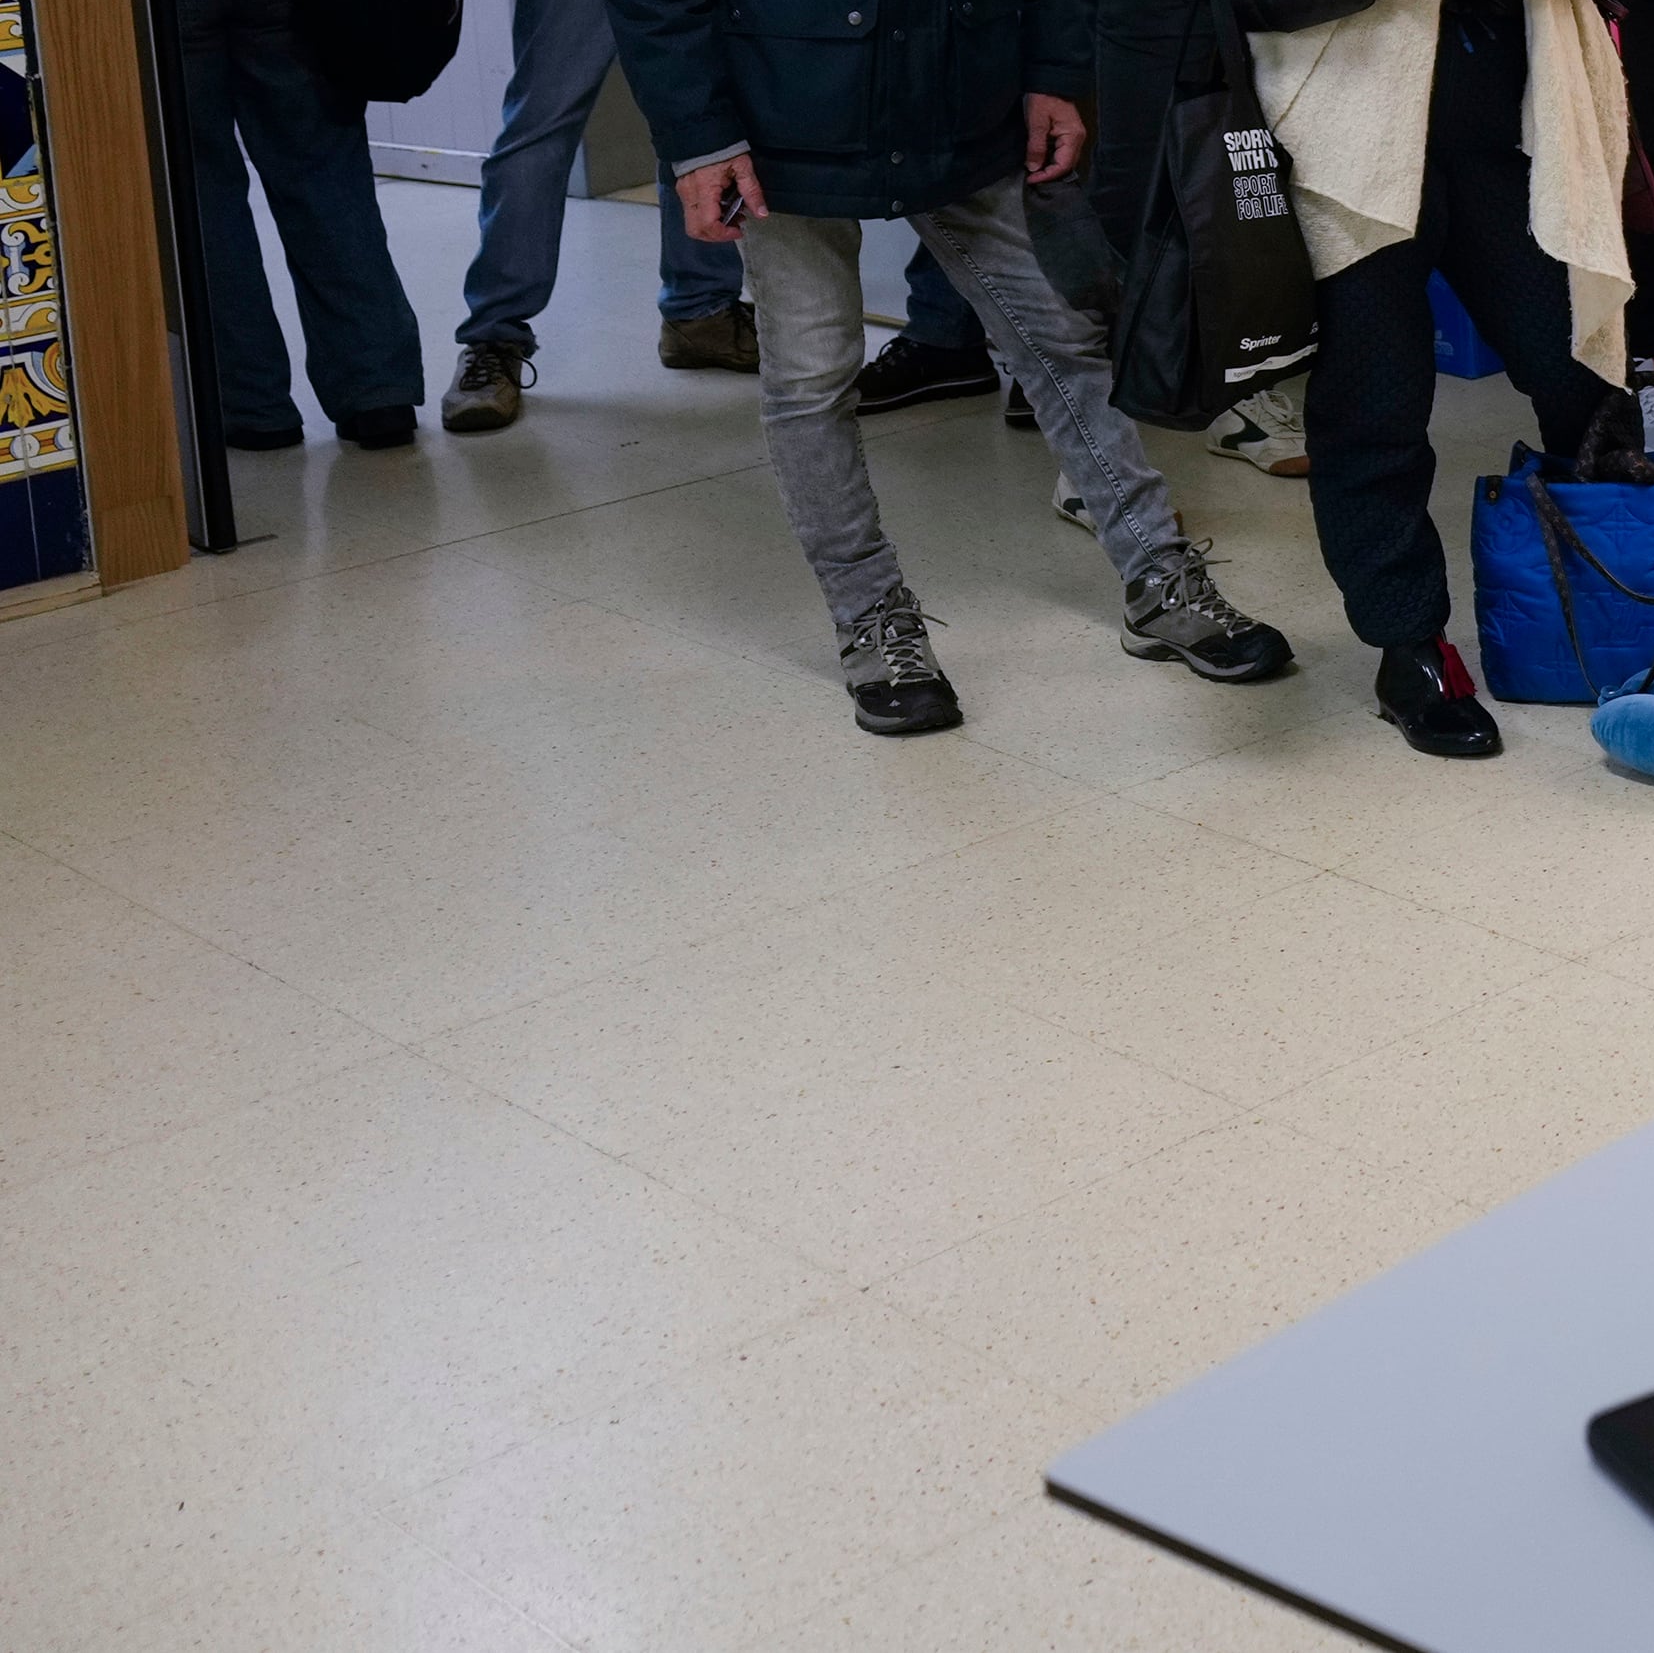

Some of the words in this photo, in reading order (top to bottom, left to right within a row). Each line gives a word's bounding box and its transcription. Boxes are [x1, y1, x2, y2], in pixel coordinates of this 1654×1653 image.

[1228, 149, 1265, 172] WITH
[1233, 173, 1277, 198] SPORT
[1236, 197, 1263, 221] FOR
[1240, 335, 1282, 351] Sprinter
